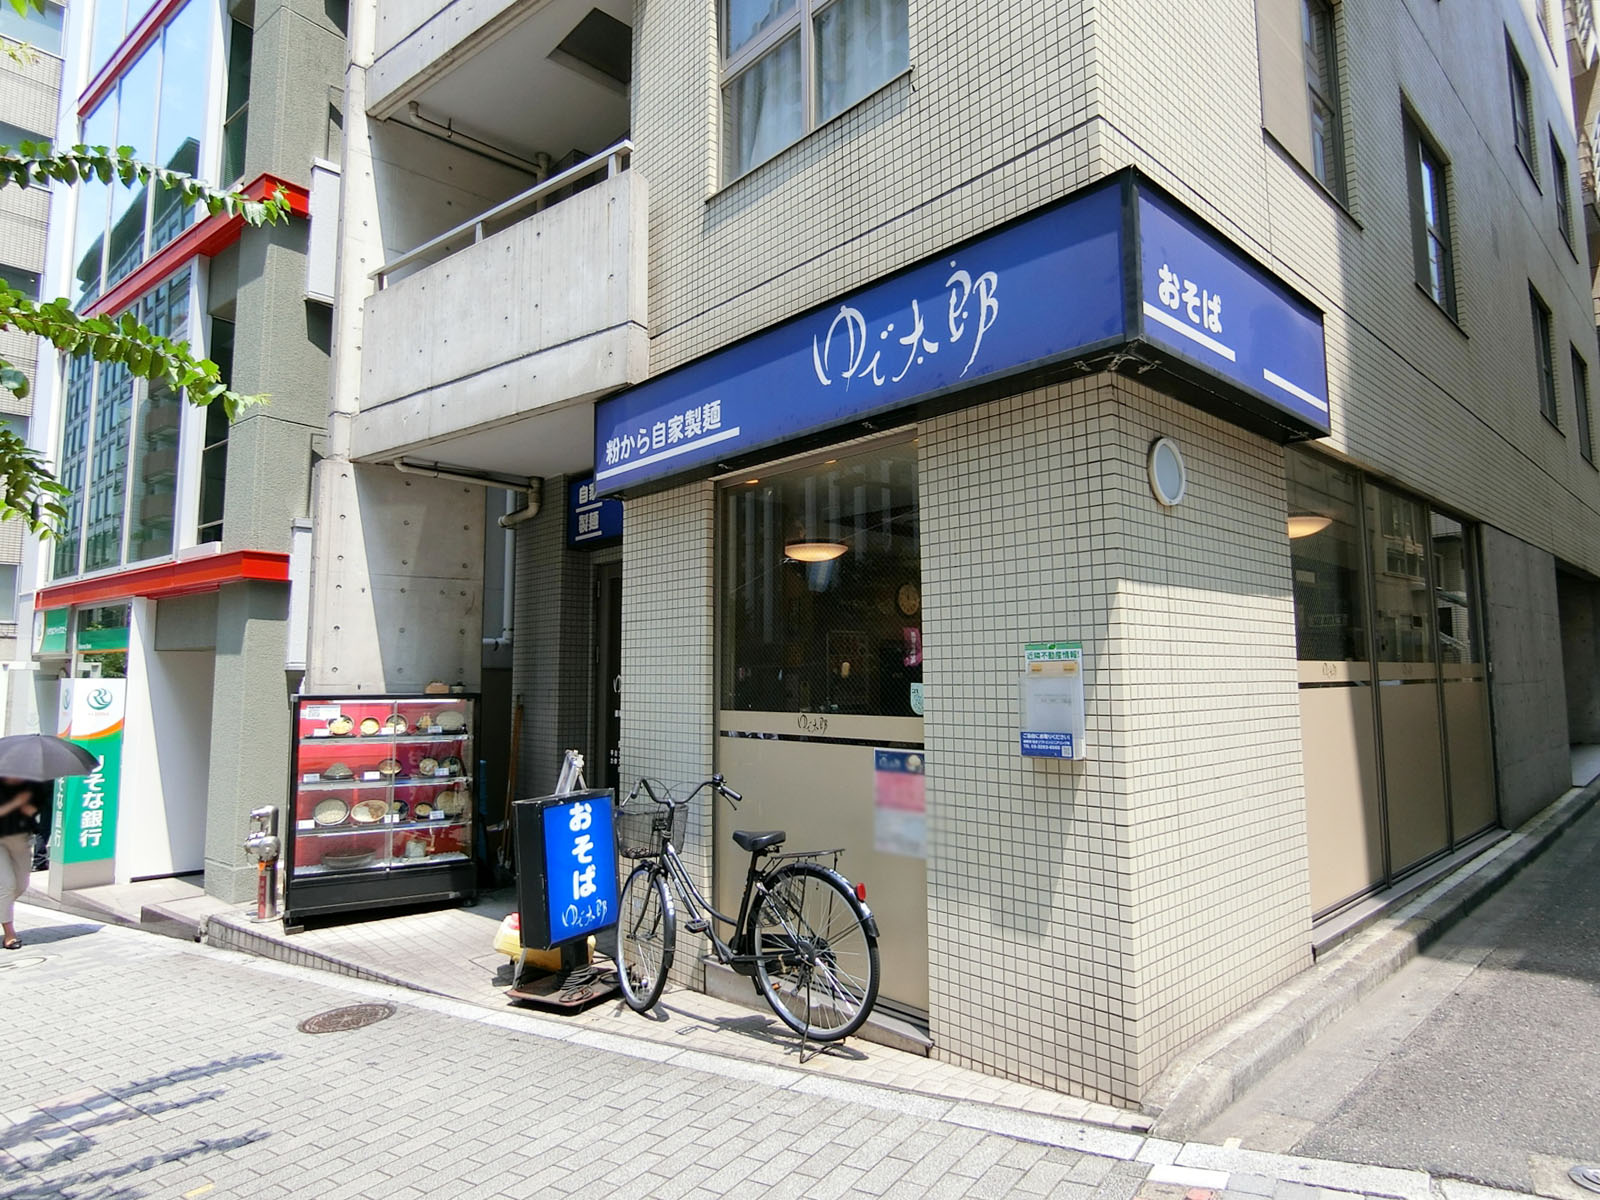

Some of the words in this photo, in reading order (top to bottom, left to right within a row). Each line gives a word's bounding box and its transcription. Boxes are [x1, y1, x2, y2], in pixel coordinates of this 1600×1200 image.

[812, 260, 999, 393] ゆで太郎
[1157, 263, 1223, 334] おそば
[605, 399, 722, 466] 粉から自家製麺
[578, 510, 600, 534] 製麺
[568, 801, 597, 901] おそば
